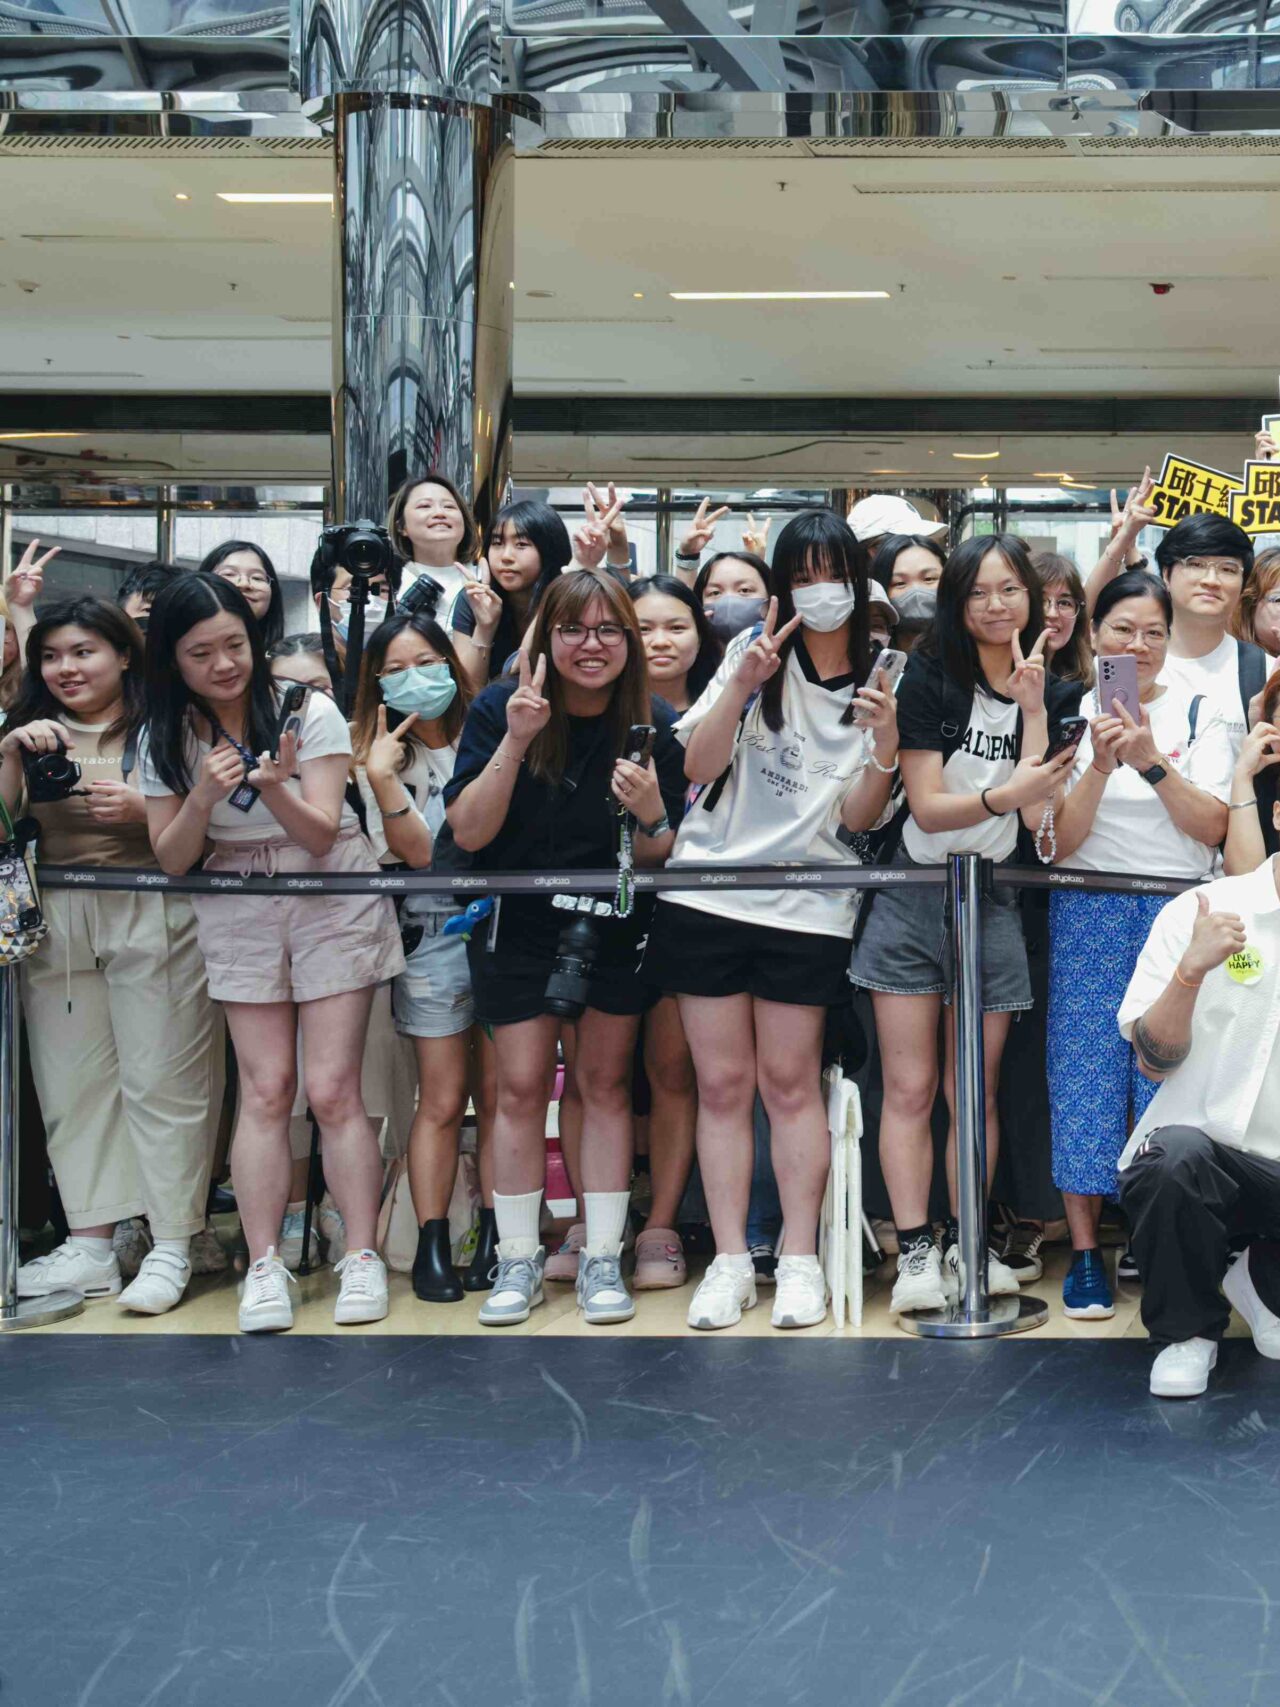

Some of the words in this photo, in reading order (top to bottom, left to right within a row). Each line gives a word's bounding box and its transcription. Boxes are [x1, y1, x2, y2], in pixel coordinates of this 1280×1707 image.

[1049, 873, 1085, 884] cityplaza
[1131, 879, 1167, 890] cityplaza
[1232, 953, 1252, 962] LIVE
[1228, 960, 1260, 969] HAPPY
